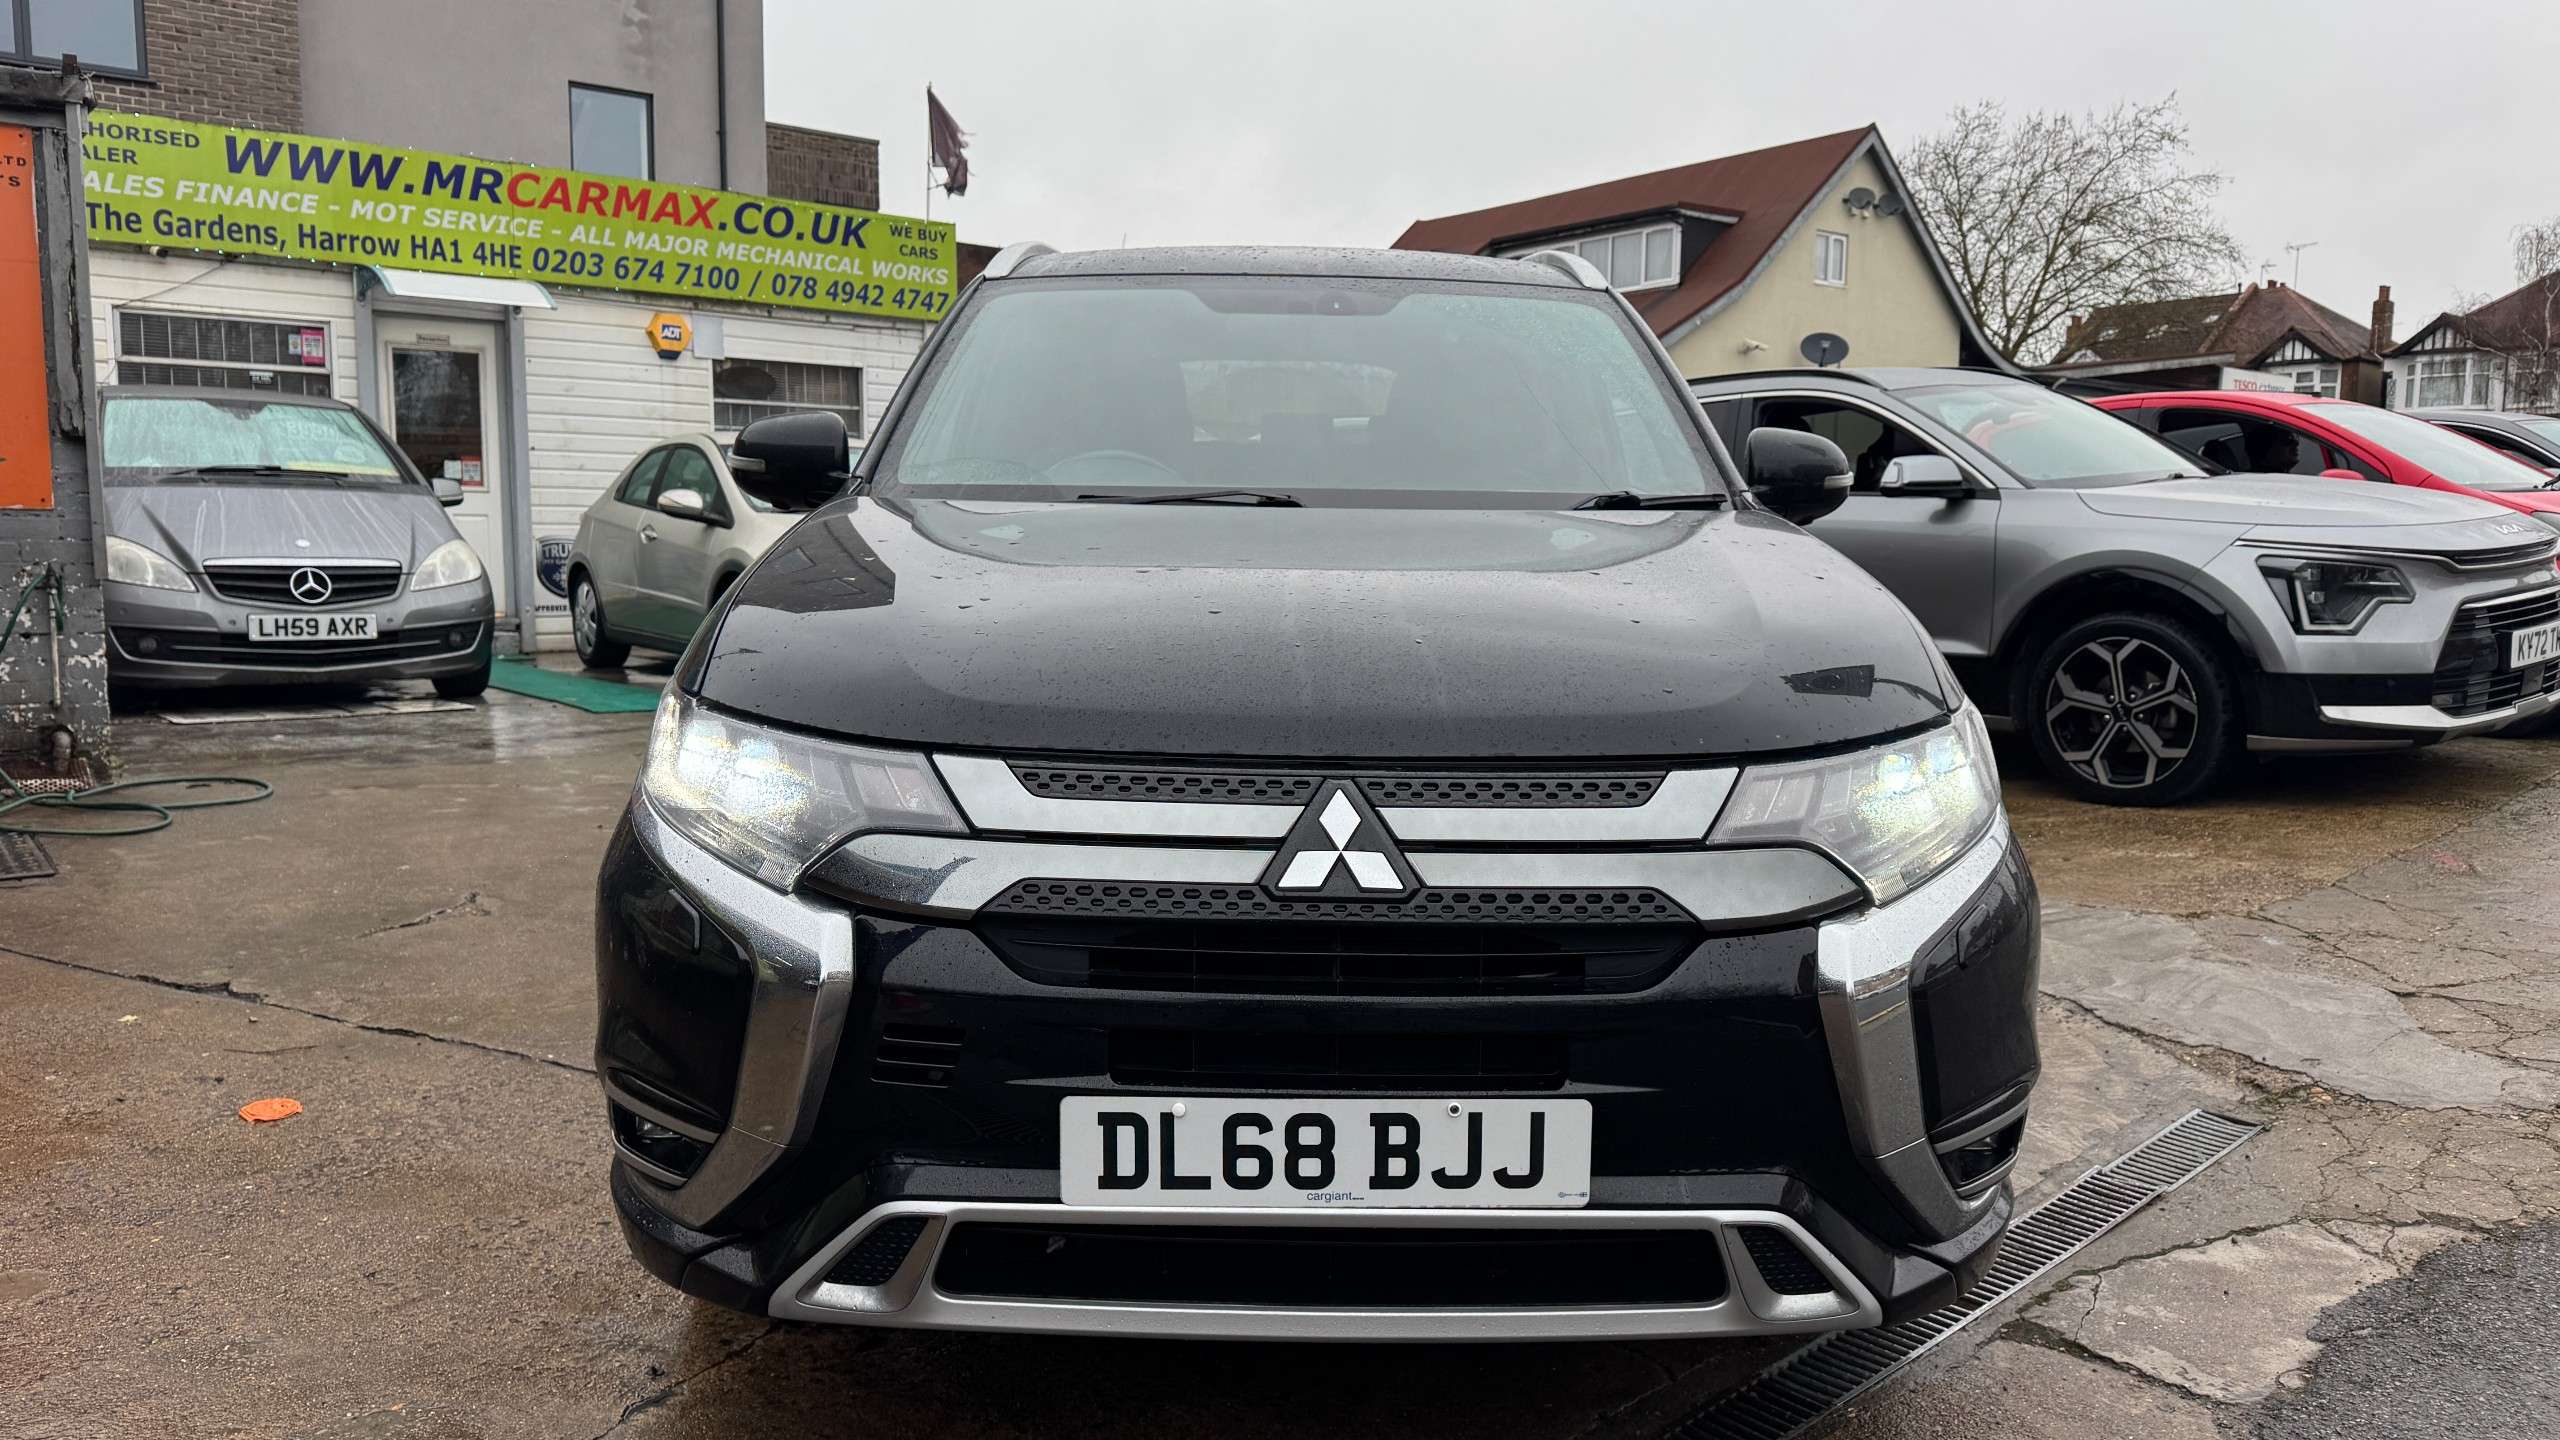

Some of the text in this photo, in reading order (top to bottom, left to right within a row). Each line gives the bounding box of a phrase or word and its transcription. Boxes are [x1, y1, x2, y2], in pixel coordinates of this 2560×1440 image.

[0, 156, 27, 167] TD
[225, 135, 870, 249] WWW.MRCARMAX.CO.UK
[176, 180, 319, 214] FINANCE
[350, 199, 416, 225] MOT
[423, 207, 544, 239] SERVICE
[569, 224, 615, 247] ALL
[624, 230, 709, 257] MAJOR
[716, 241, 864, 276] MECHANICAL
[872, 260, 949, 285] WORKS
[889, 224, 947, 242] WE BUY
[86, 202, 949, 313] The Gardens, Harrow HA1 4HE 0203 674 7100 / 078 4942 4747
[899, 244, 938, 260] CARS
[661, 326, 682, 340] ADT
[542, 543, 572, 558] TRU
[258, 617, 368, 636] LH59 AXR
[2517, 629, 2548, 661] KY72
[1098, 1112, 1545, 1190] DL68 BJJ
